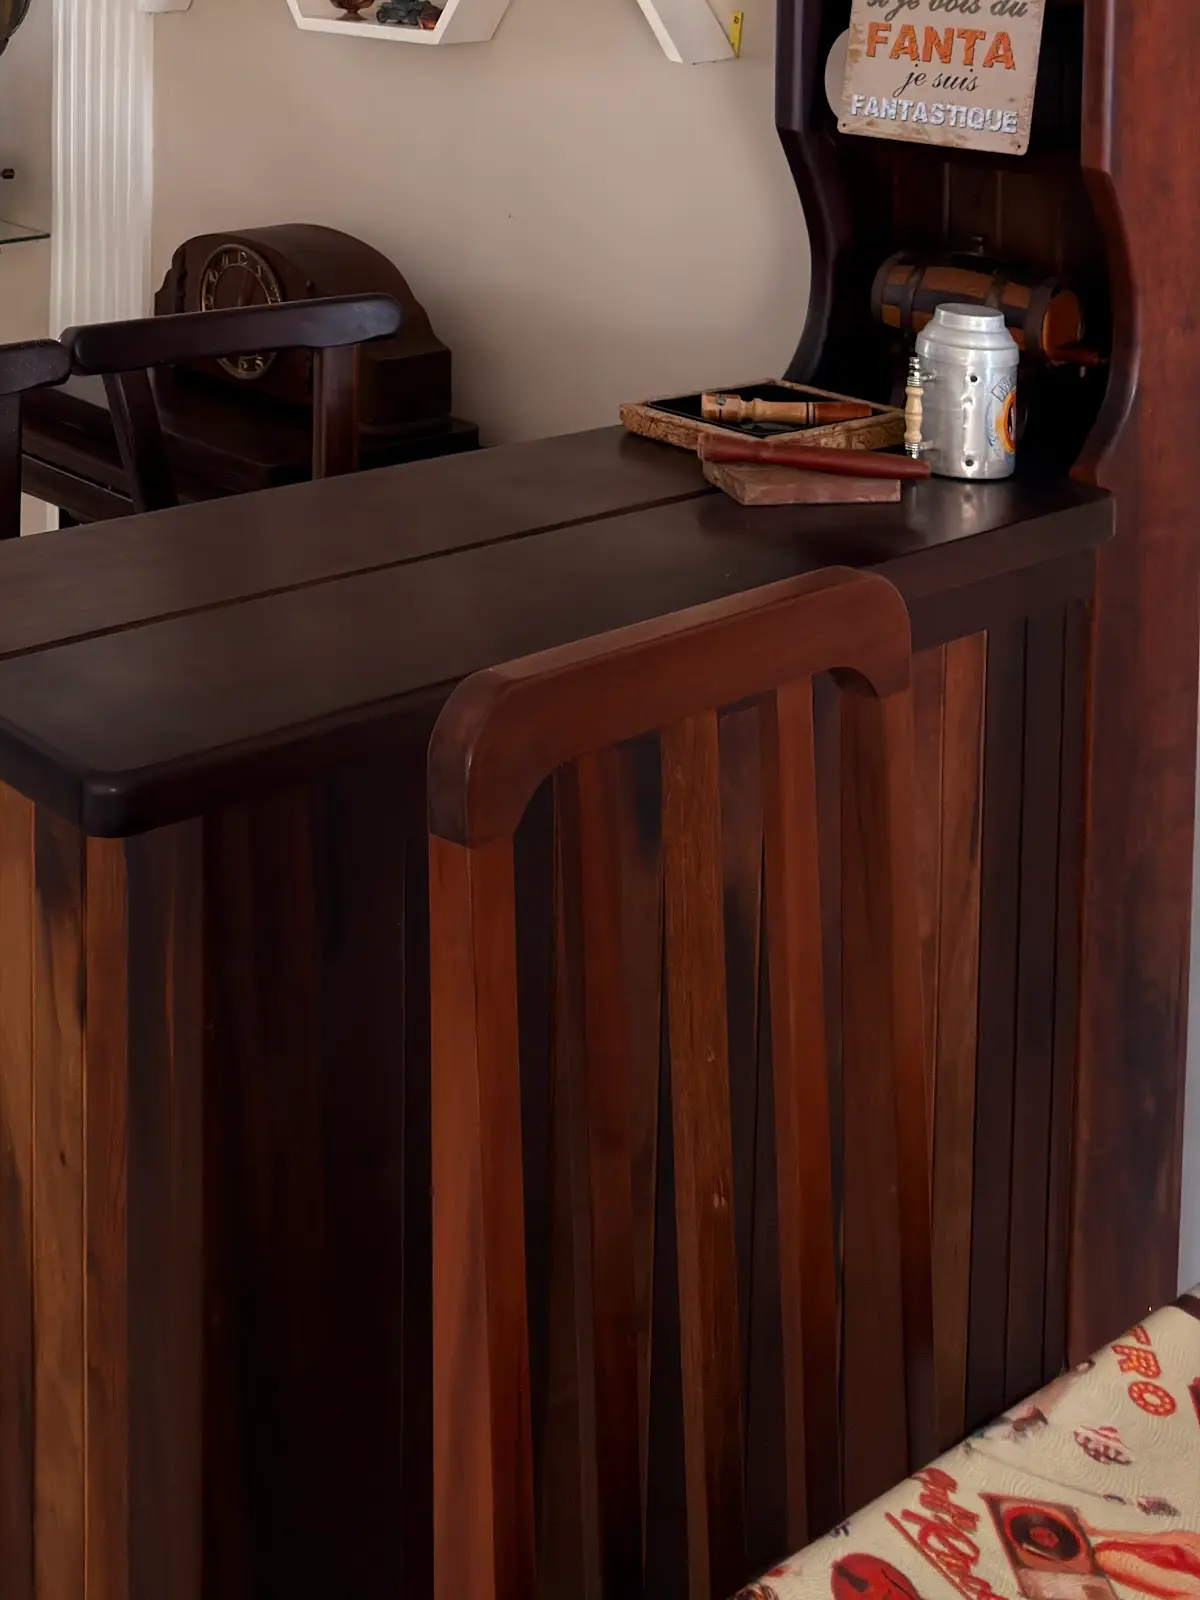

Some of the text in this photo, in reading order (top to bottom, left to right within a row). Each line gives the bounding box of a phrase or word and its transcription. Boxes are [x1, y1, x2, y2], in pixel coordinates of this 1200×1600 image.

[865, 21, 1016, 71] FANTA
[892, 63, 980, 98] je suis
[851, 93, 1019, 134] FANTASTIQUE
